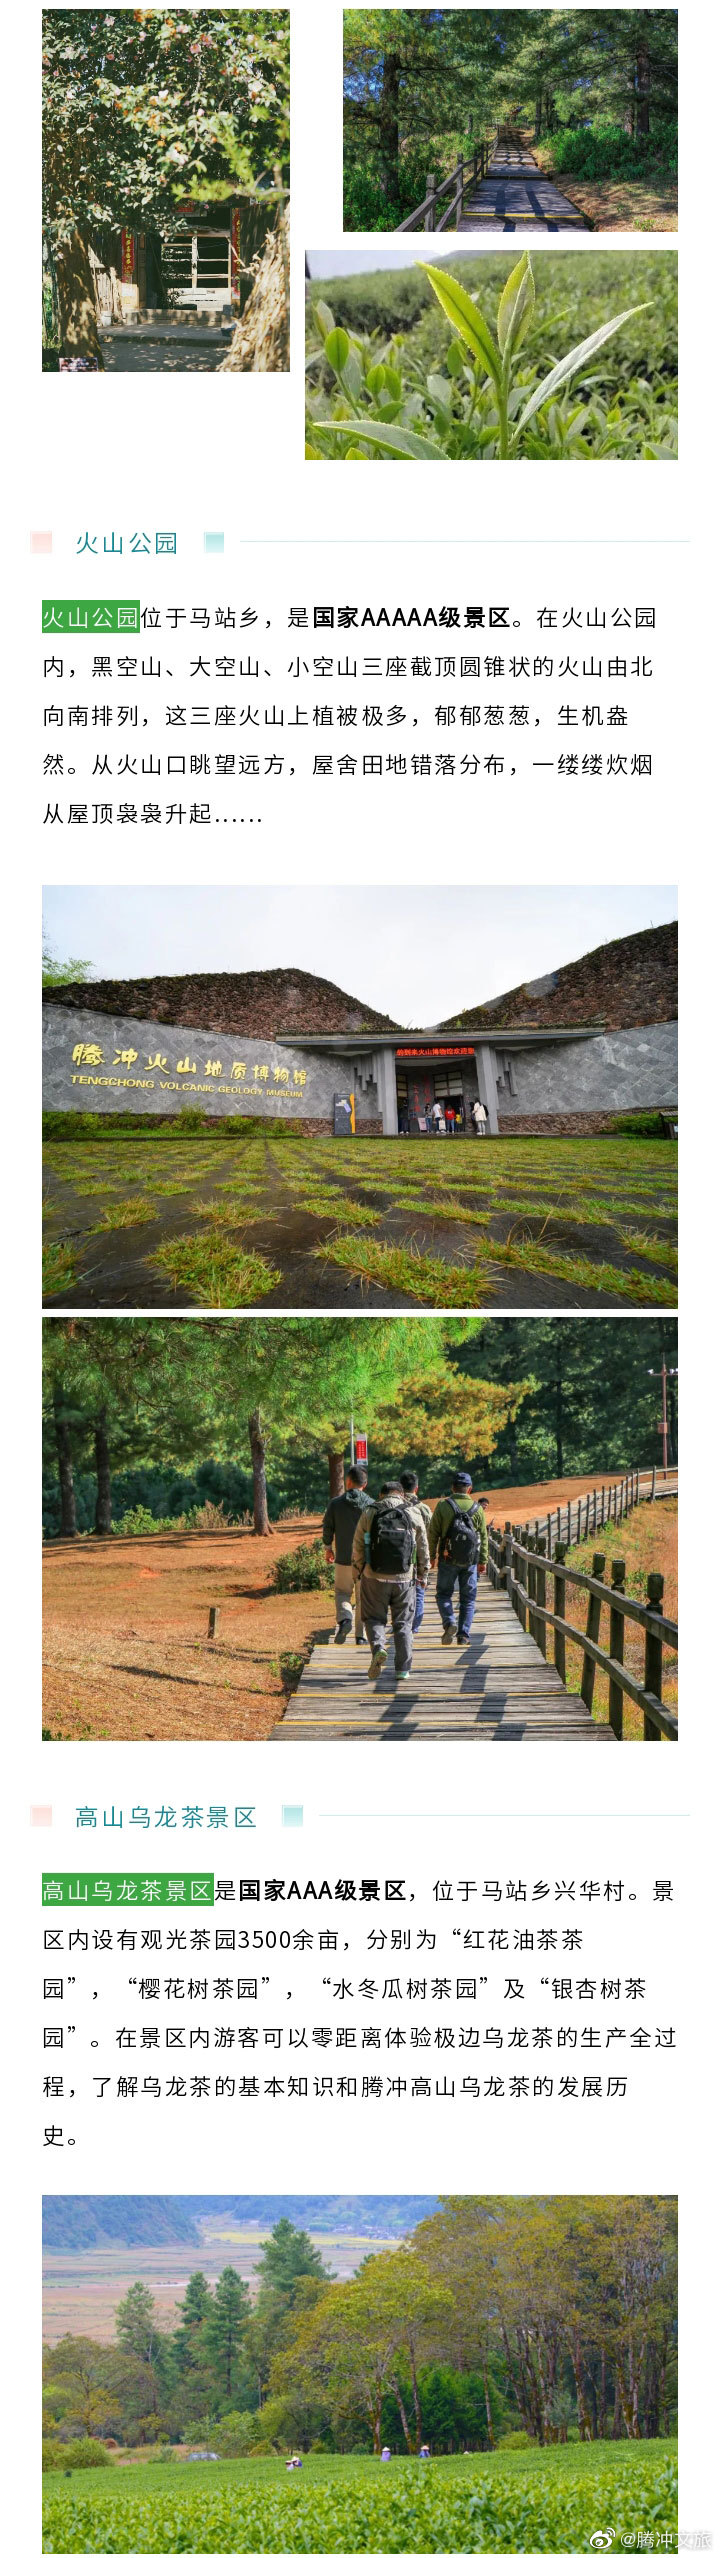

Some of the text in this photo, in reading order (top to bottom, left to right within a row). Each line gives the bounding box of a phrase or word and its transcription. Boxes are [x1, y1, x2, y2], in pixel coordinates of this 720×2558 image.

[72, 1043, 307, 1086] 腾冲火山地质博物馆
[70, 1075, 304, 1098] TENGCHONG VOLCANIC GEOLOGY MUSEUM
